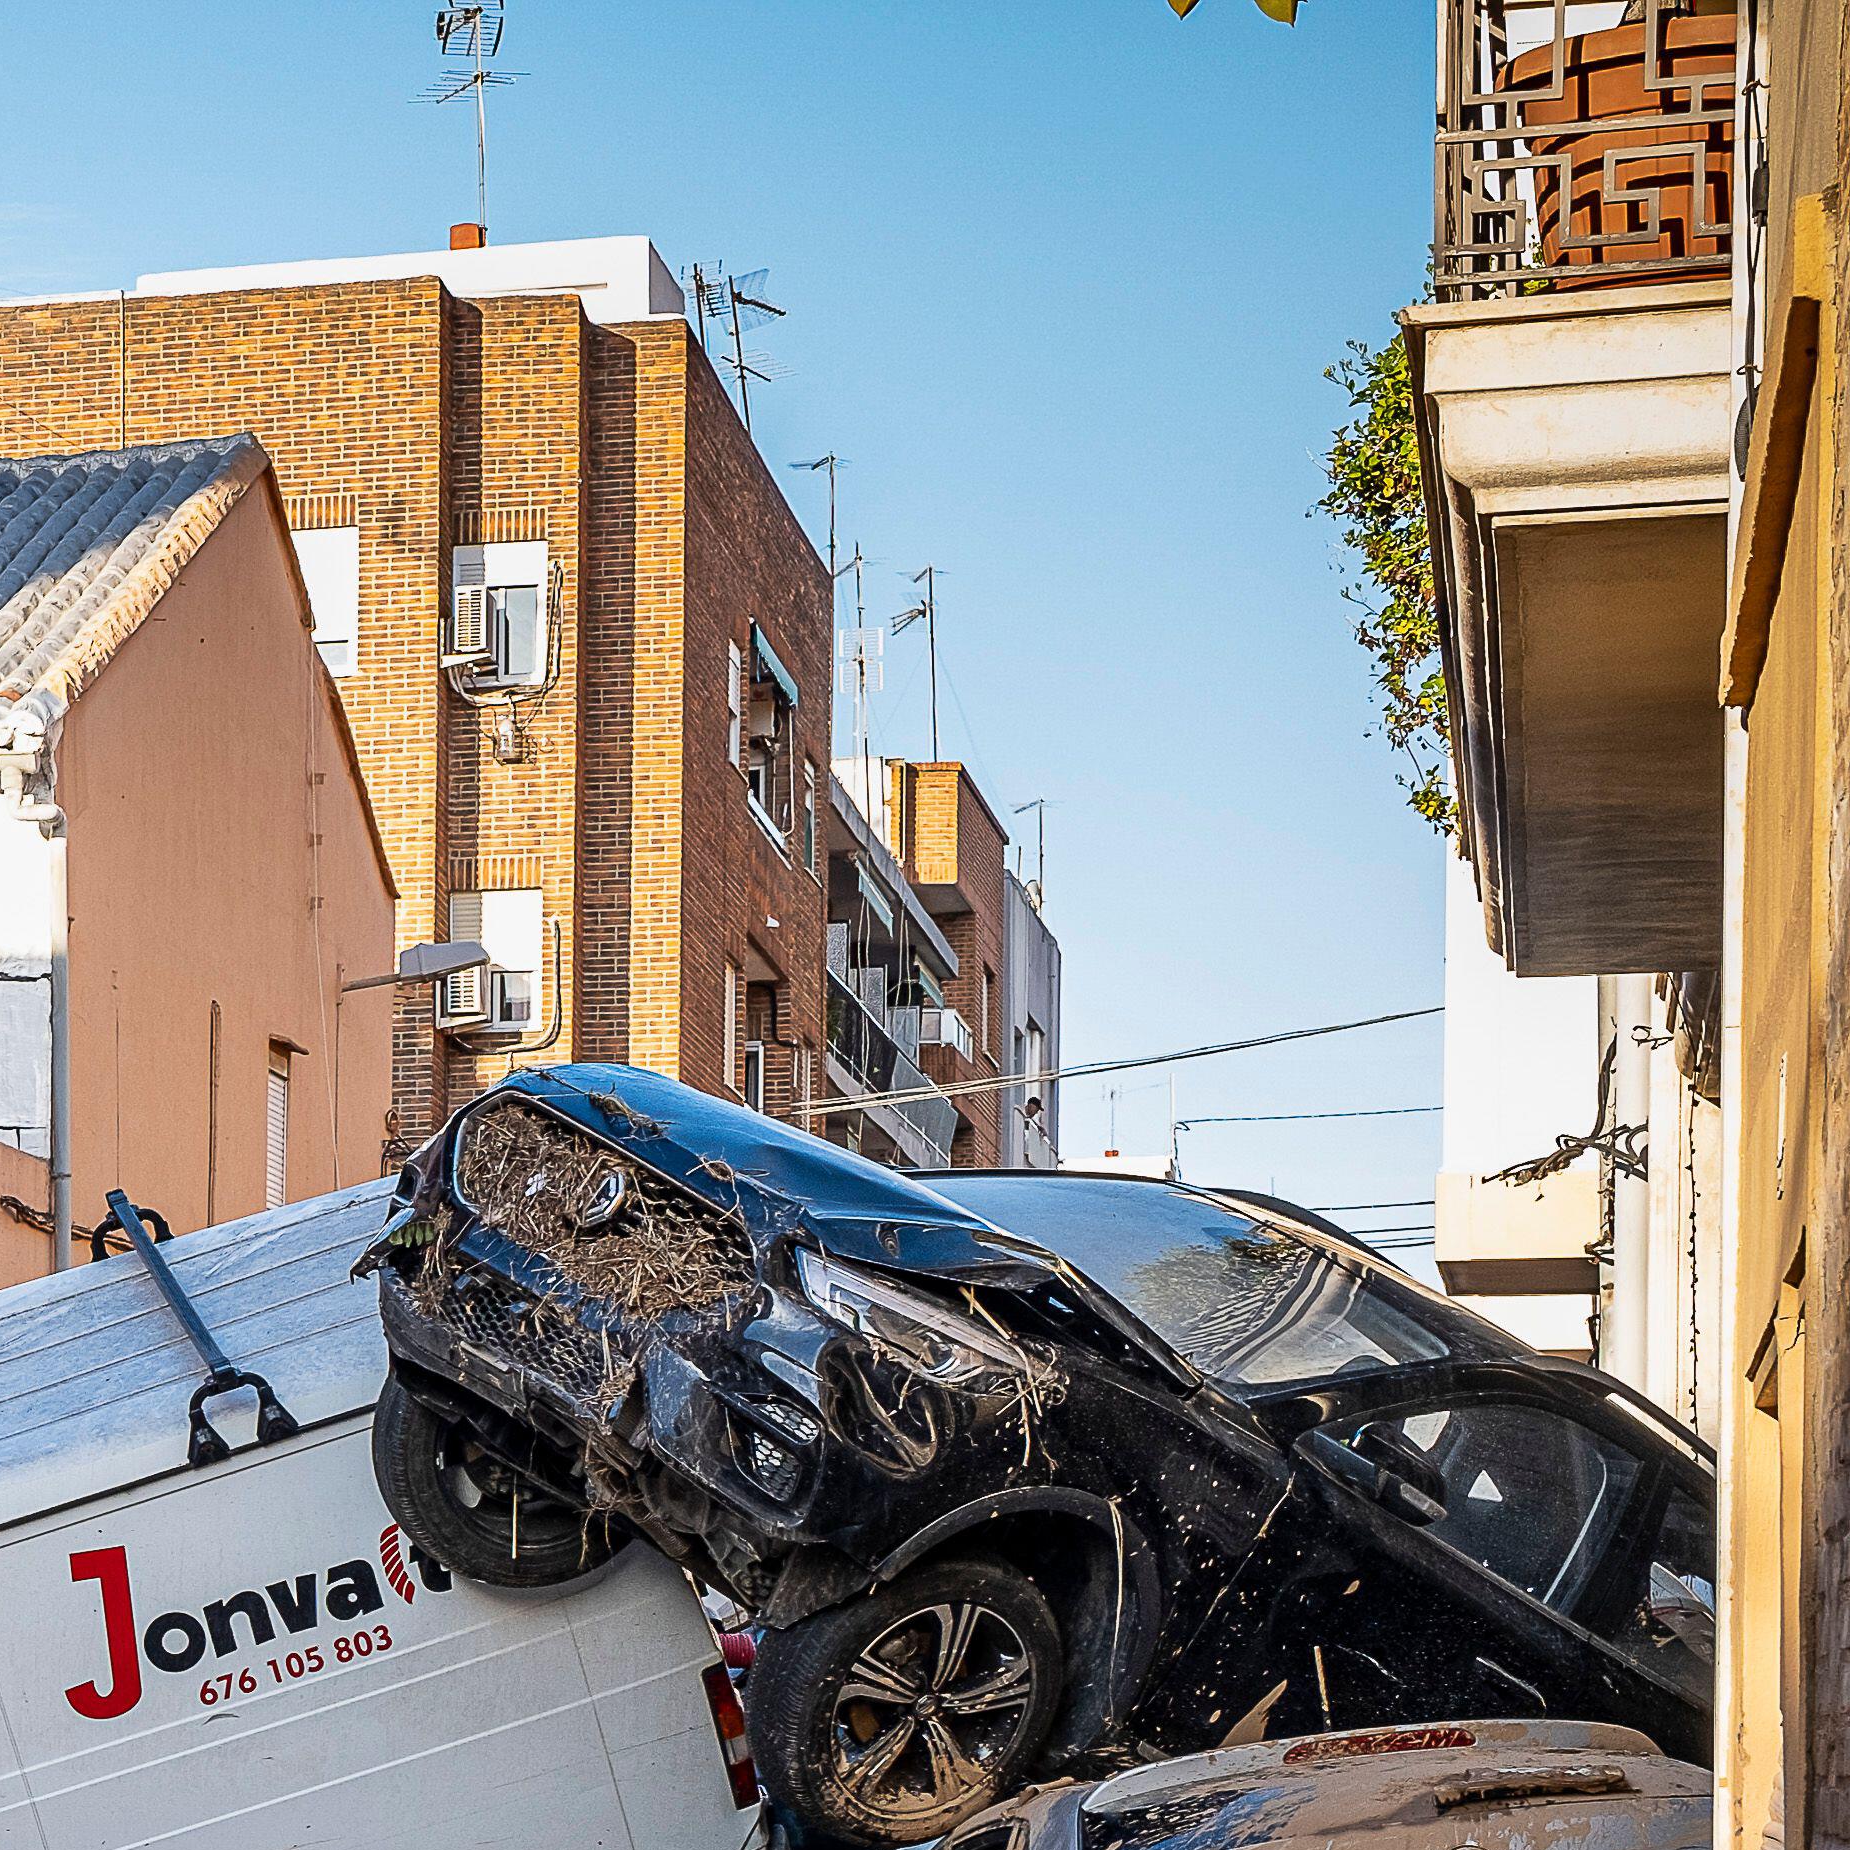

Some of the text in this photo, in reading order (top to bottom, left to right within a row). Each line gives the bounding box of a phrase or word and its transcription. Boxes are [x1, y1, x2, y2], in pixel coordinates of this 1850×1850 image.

[200, 1624, 394, 1705] 676 105 803
